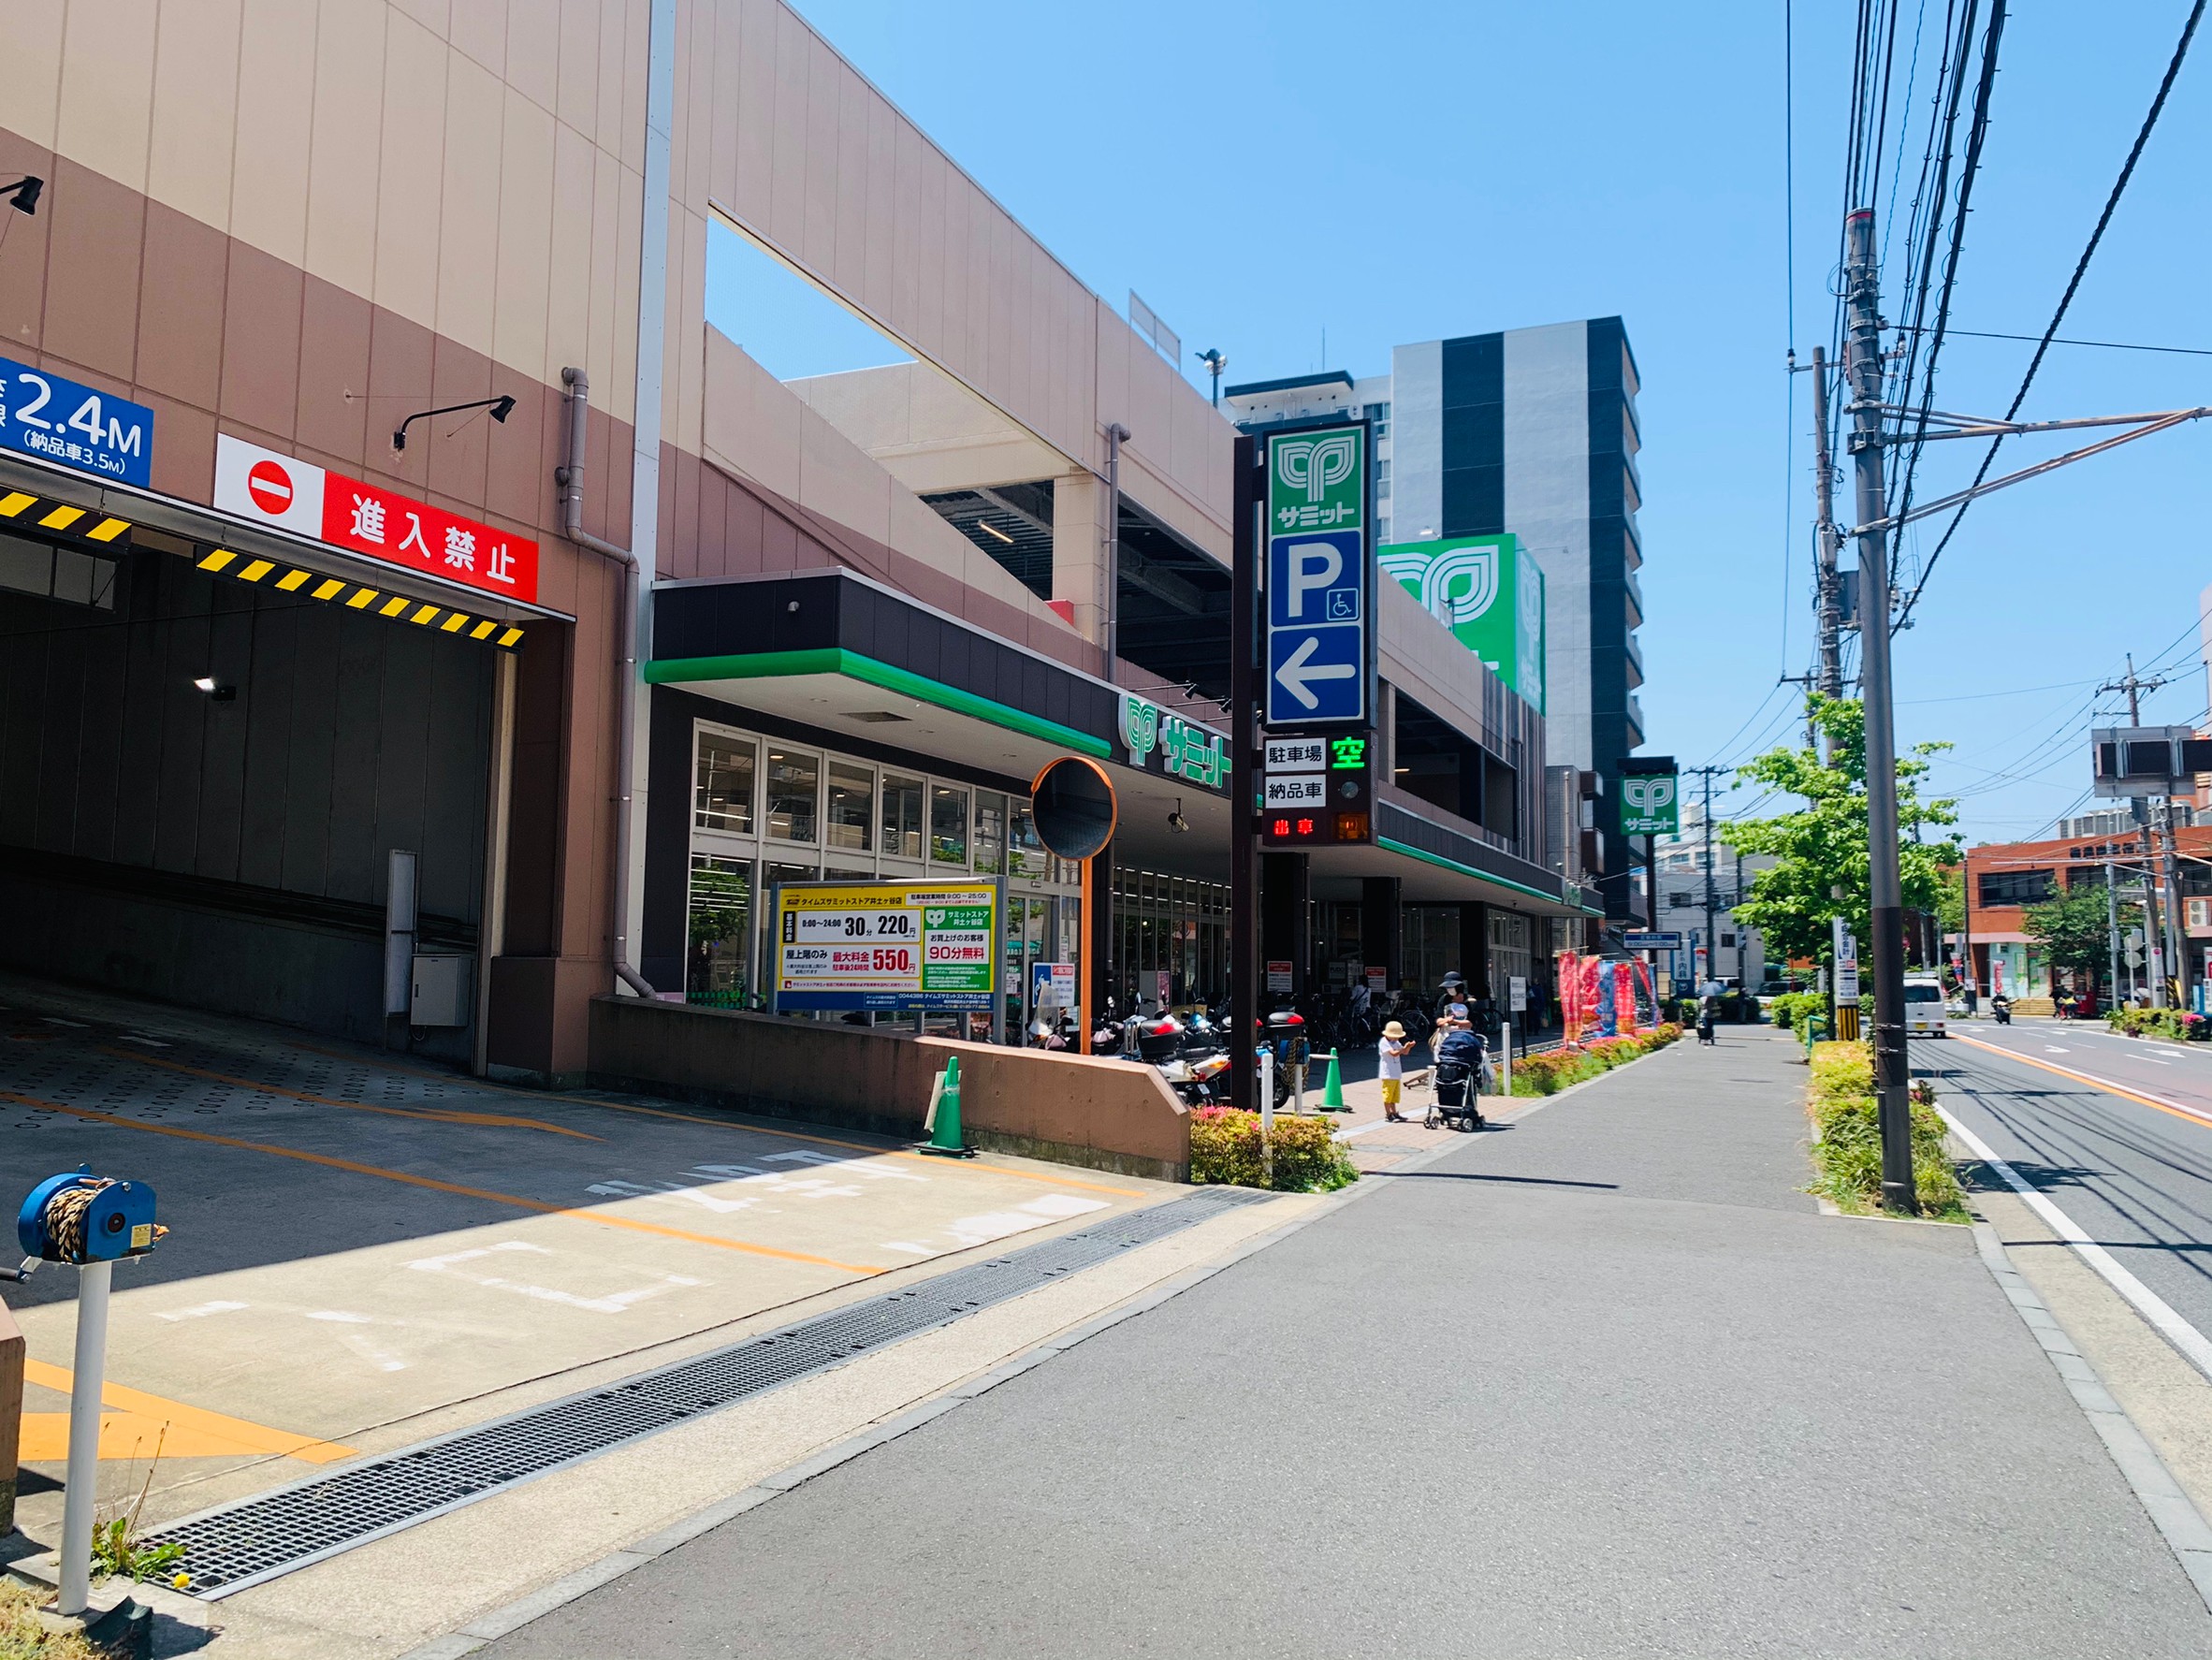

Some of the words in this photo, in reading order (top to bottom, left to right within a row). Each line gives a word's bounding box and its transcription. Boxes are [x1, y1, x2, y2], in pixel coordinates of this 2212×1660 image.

[15, 373, 141, 458] 2.4M
[1278, 502, 1355, 529] サミット
[349, 493, 516, 584] 進入禁止
[1288, 542, 1343, 618] P
[1158, 716, 1232, 789] サミット
[1268, 745, 1322, 764] 駐車場
[1332, 736, 1365, 769] 空
[1268, 782, 1322, 800] 納品車
[1624, 817, 1675, 831] サミット
[930, 934, 983, 942] お買上げのお客様
[786, 950, 827, 959] 屋上階のみ
[832, 951, 870, 962] 最大料金
[929, 946, 984, 960] 90分無料
